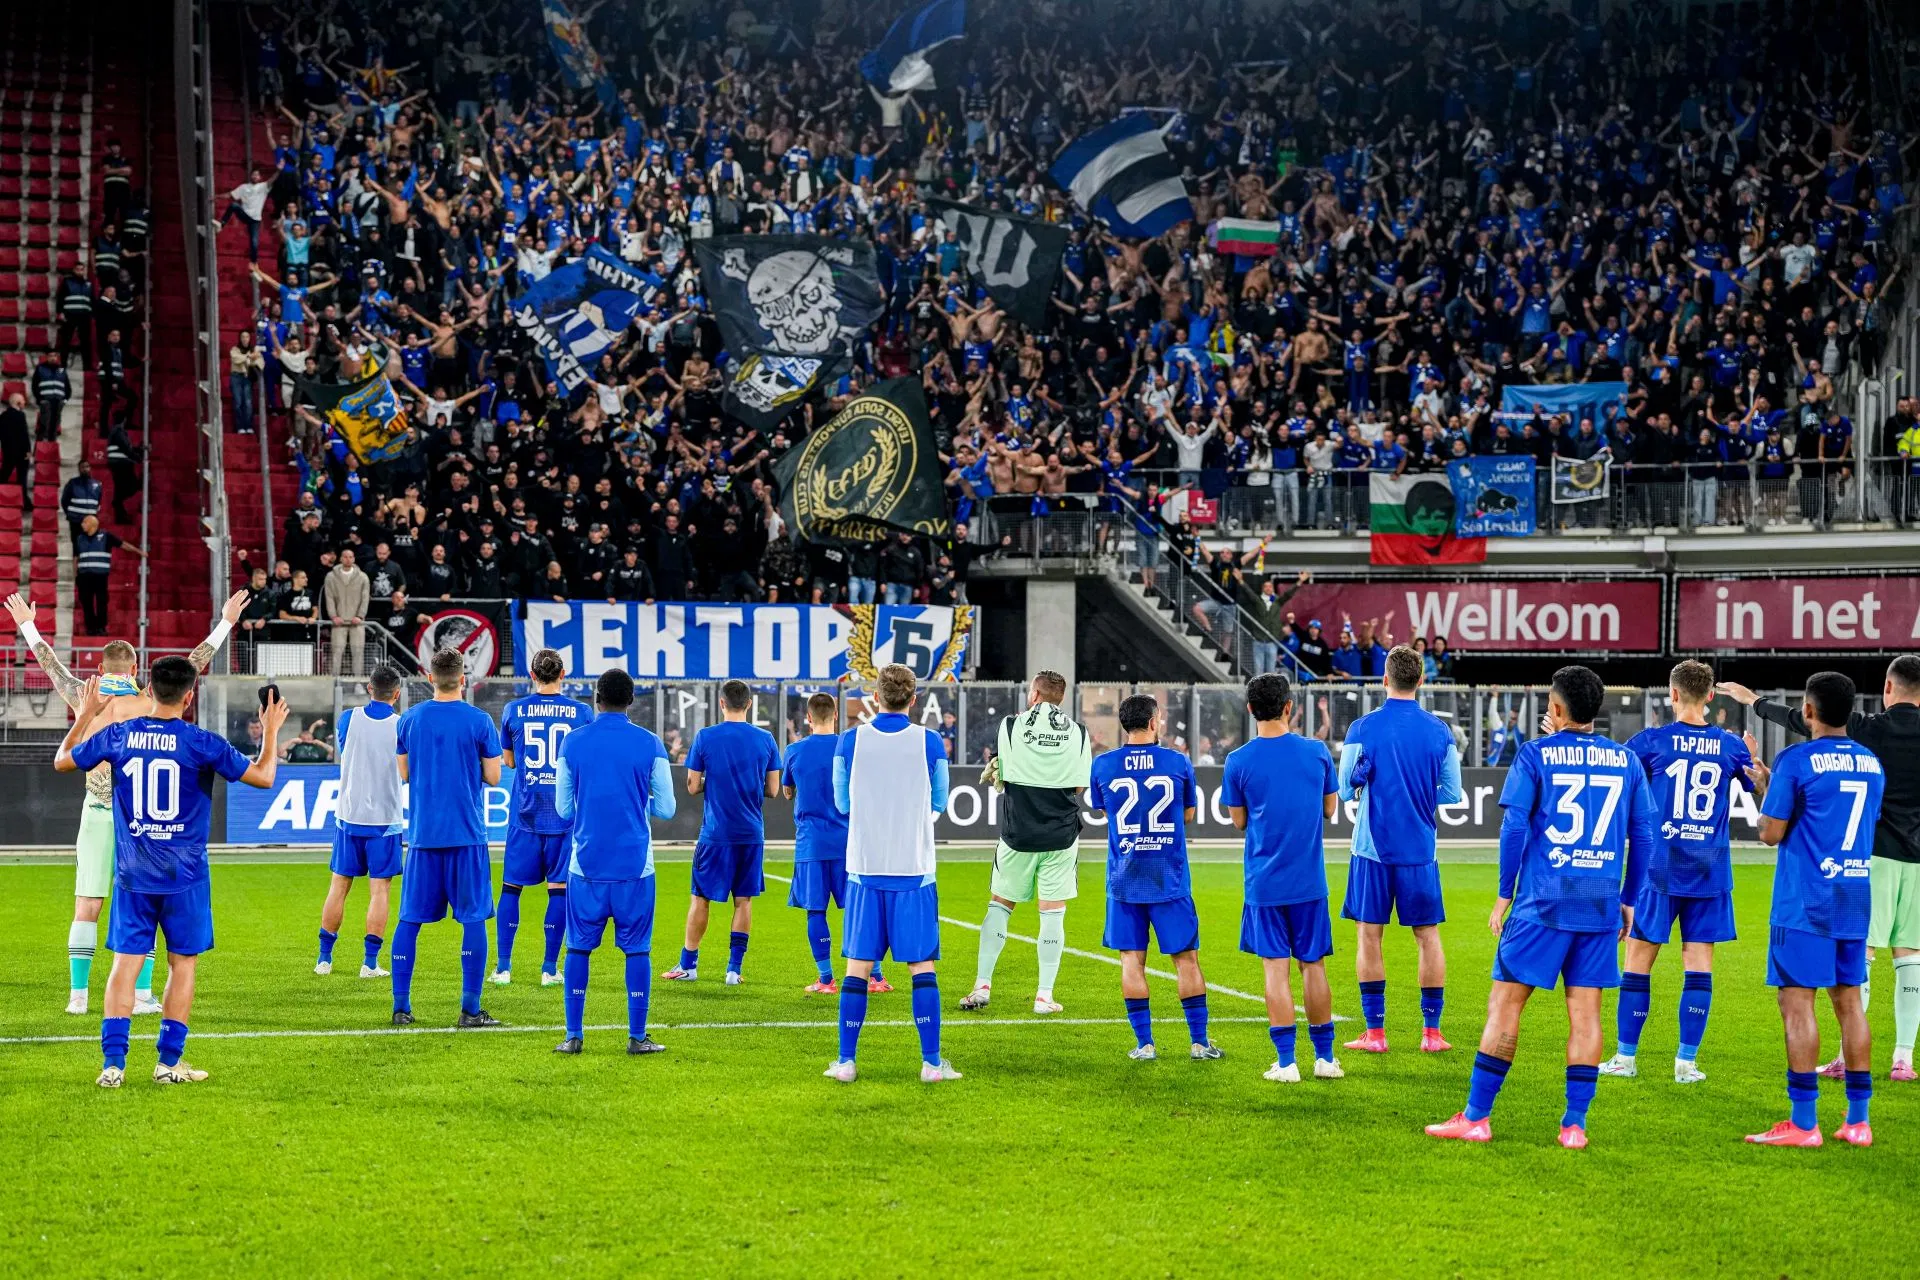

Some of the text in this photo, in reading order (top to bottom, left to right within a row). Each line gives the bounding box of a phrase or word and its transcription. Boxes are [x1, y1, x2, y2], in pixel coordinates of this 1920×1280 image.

[1406, 588, 1620, 642] Welkom
[1715, 587, 1764, 640] in
[1792, 586, 1881, 640] het
[524, 603, 934, 679] СЕКТОР Б
[517, 704, 577, 718] К. ДИМИТРОВ
[127, 732, 177, 751] МИТКОВ
[523, 722, 572, 769] 50
[1038, 733, 1069, 741] PALMS
[1672, 735, 1721, 755] ТЪРДИН
[1124, 755, 1154, 771] СУЛА
[1541, 745, 1628, 767] РИЛДО ФИЛЬО
[1810, 753, 1854, 774] ФАБИО
[122, 757, 180, 821] 10
[1665, 758, 1722, 821] 18
[1108, 775, 1175, 834] 22
[1544, 773, 1624, 846] 37
[1839, 780, 1868, 851] 7
[142, 823, 185, 833] PALMS
[1681, 823, 1715, 834] PALMS
[1134, 836, 1174, 844] PALMS
[1572, 849, 1616, 860] PALMS
[916, 1016, 931, 1024] 1914
[1688, 1006, 1705, 1015] 1914
[845, 1020, 860, 1028] 1914
